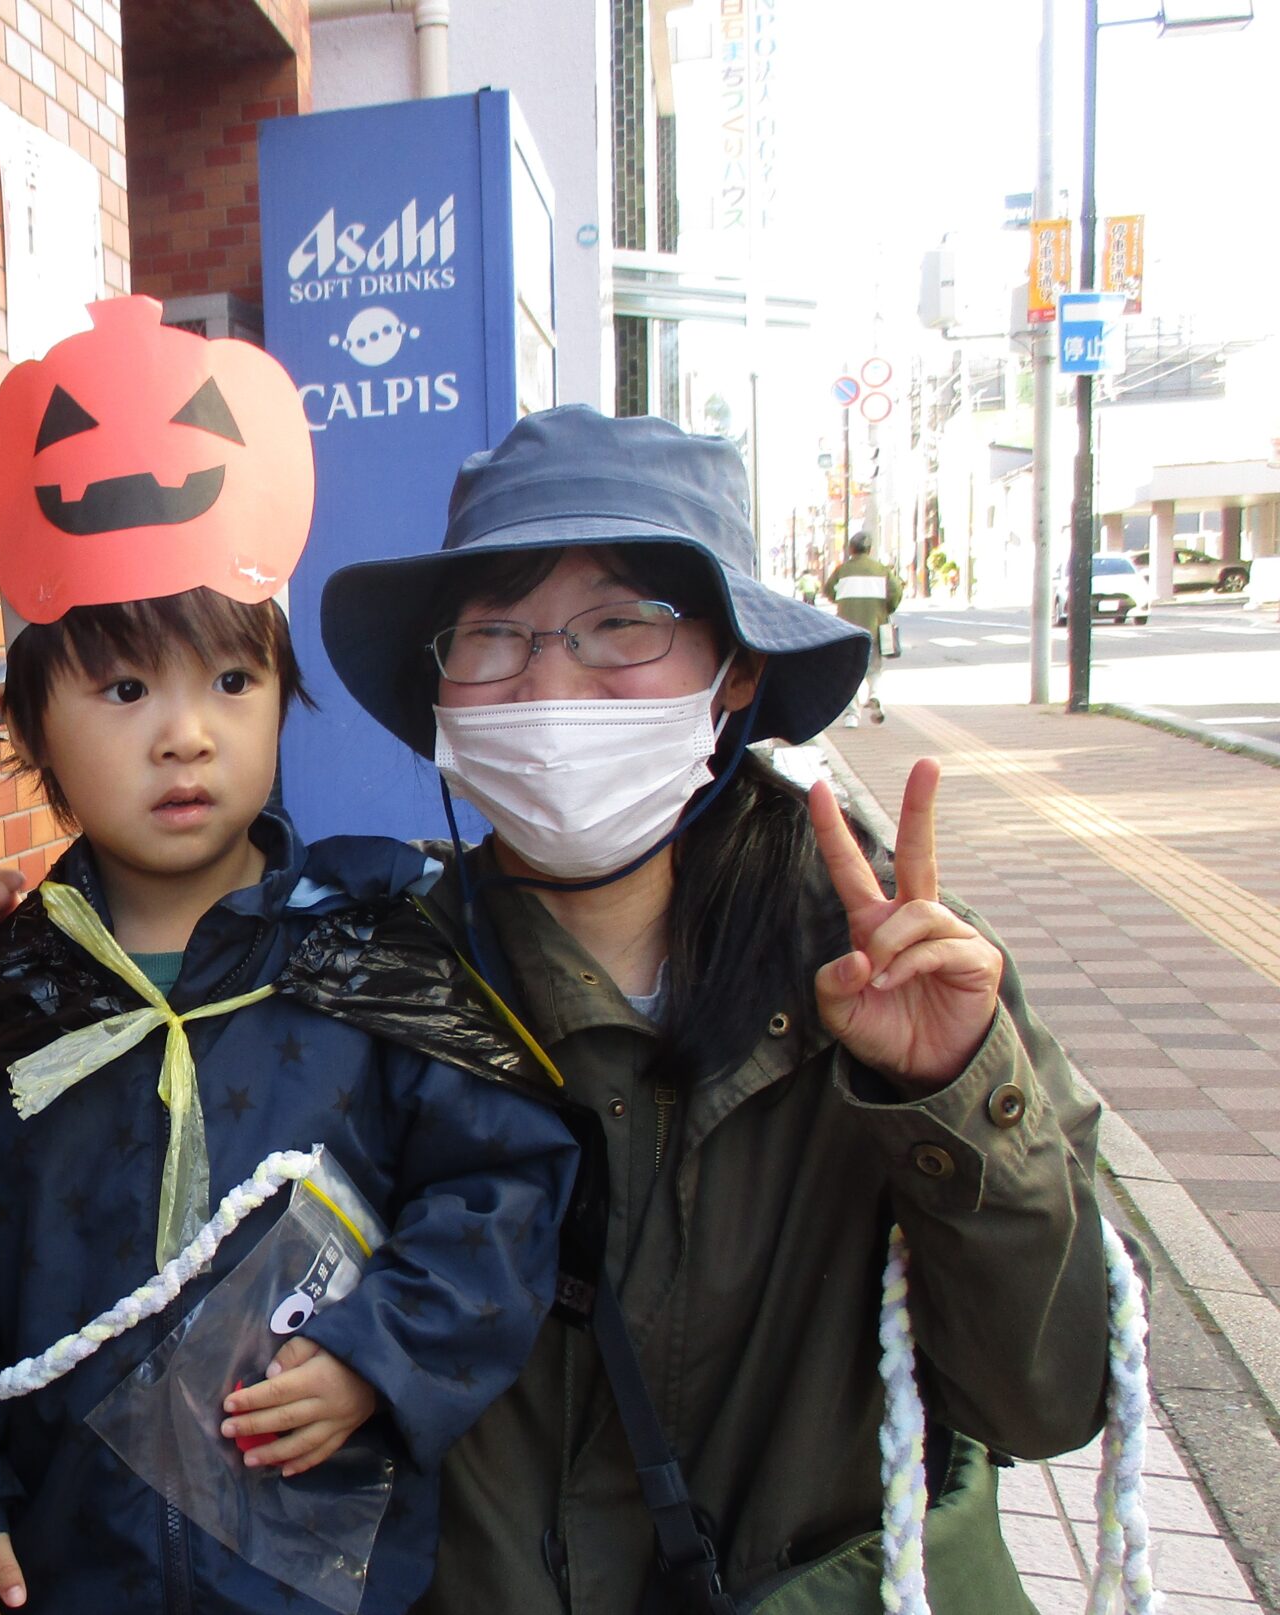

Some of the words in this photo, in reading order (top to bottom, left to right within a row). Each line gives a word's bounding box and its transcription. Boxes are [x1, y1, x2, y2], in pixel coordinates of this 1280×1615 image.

[288, 194, 455, 280] Asahi
[290, 277, 352, 304] SOFT
[359, 267, 455, 297] DRINKS
[298, 372, 459, 431] CALPIS
